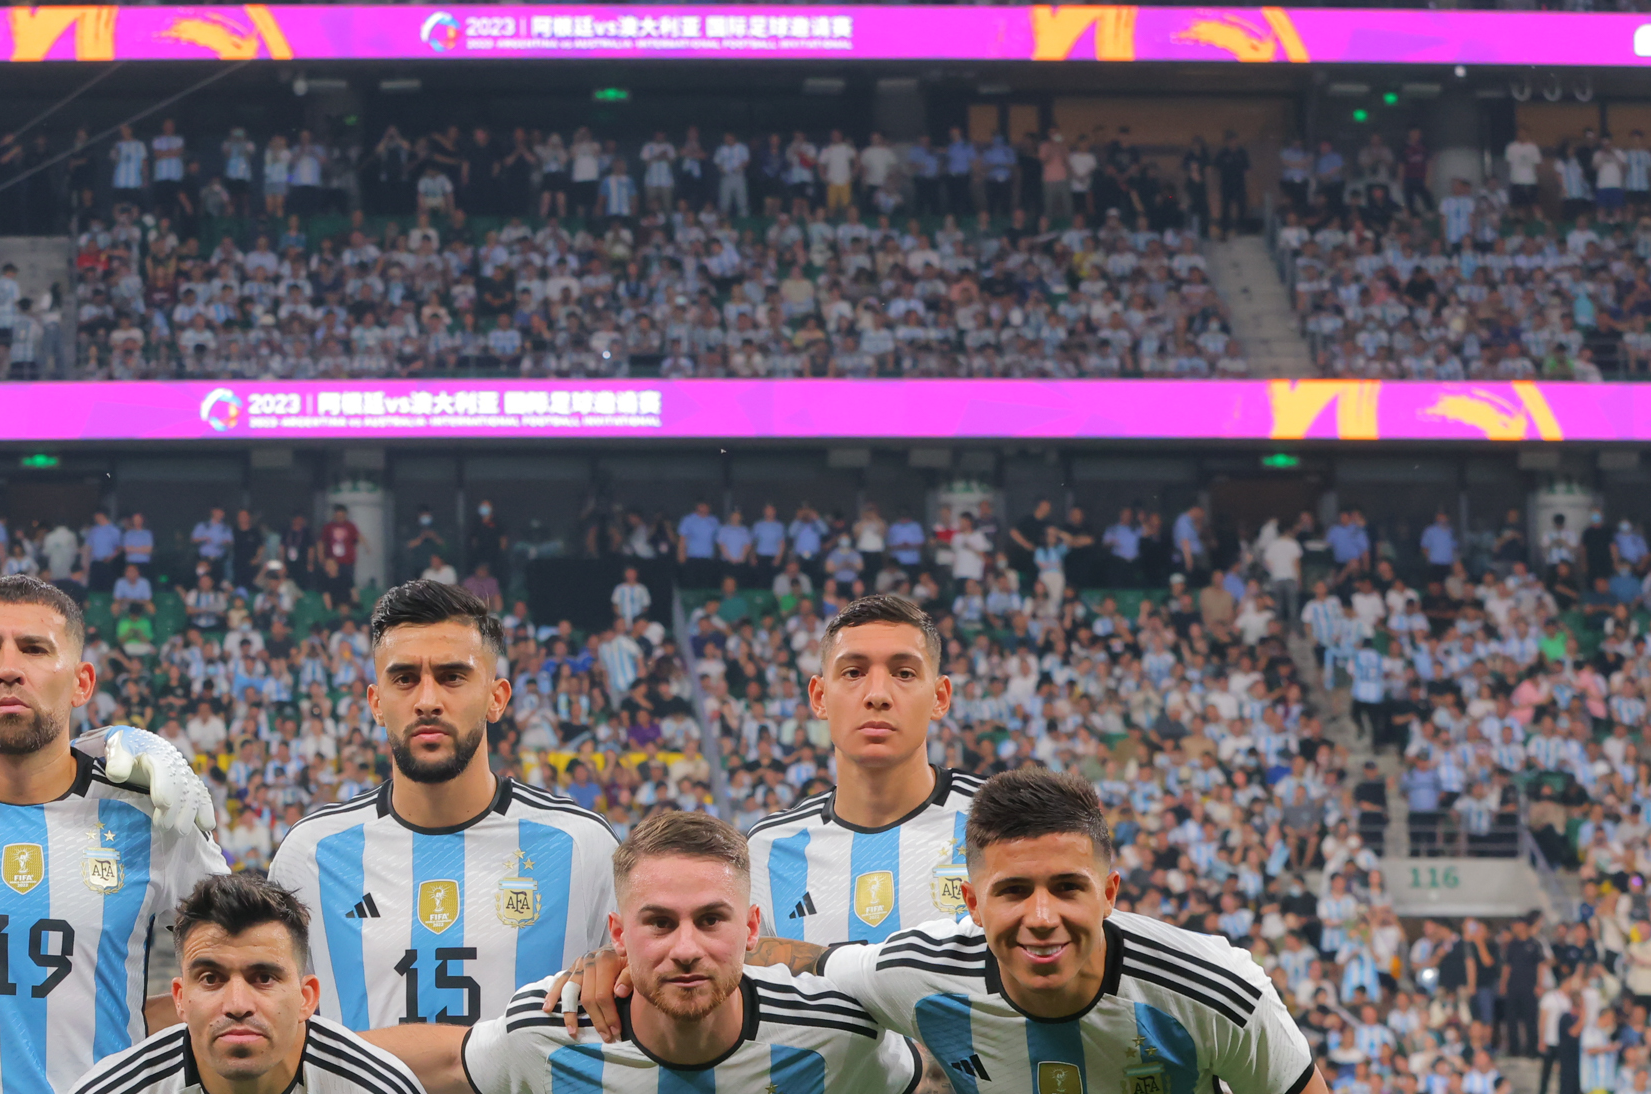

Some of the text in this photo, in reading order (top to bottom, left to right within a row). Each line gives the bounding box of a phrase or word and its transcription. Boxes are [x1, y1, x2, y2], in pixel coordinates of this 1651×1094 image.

[465, 16, 516, 37] 2023
[248, 392, 301, 415] 2023
[92, 859, 116, 881] AFA
[1411, 866, 1460, 888] 116
[506, 890, 531, 913] AFA
[866, 905, 885, 914] FIFA
[393, 947, 481, 1026] 15
